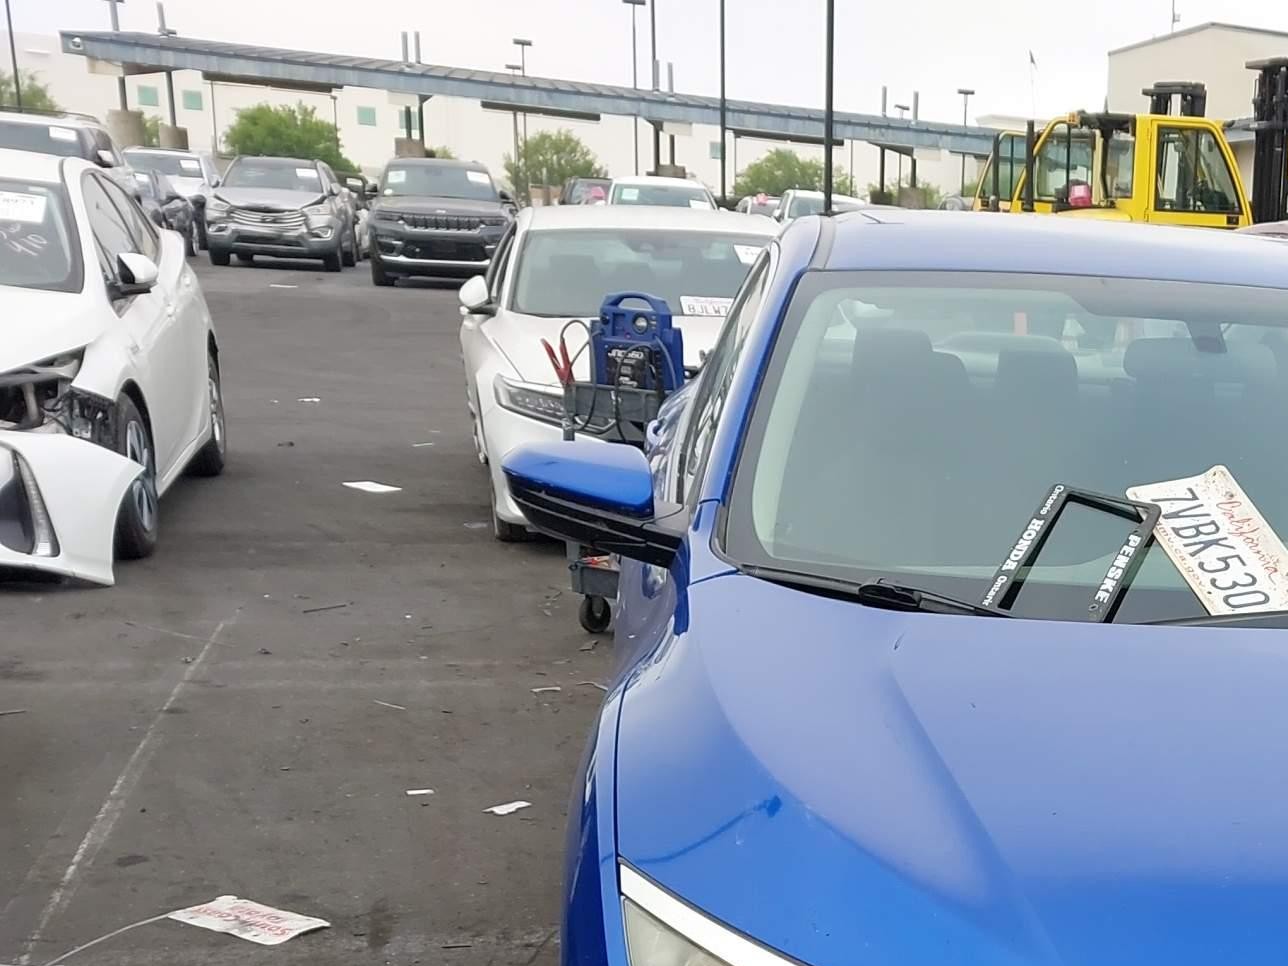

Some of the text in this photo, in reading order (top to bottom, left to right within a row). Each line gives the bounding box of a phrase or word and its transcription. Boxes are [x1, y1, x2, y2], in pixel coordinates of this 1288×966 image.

[1001, 518, 1046, 572] HONDA
[1095, 534, 1142, 604] PENSKE
[1150, 487, 1271, 609] 7VBK530
[1215, 501, 1279, 579] California
